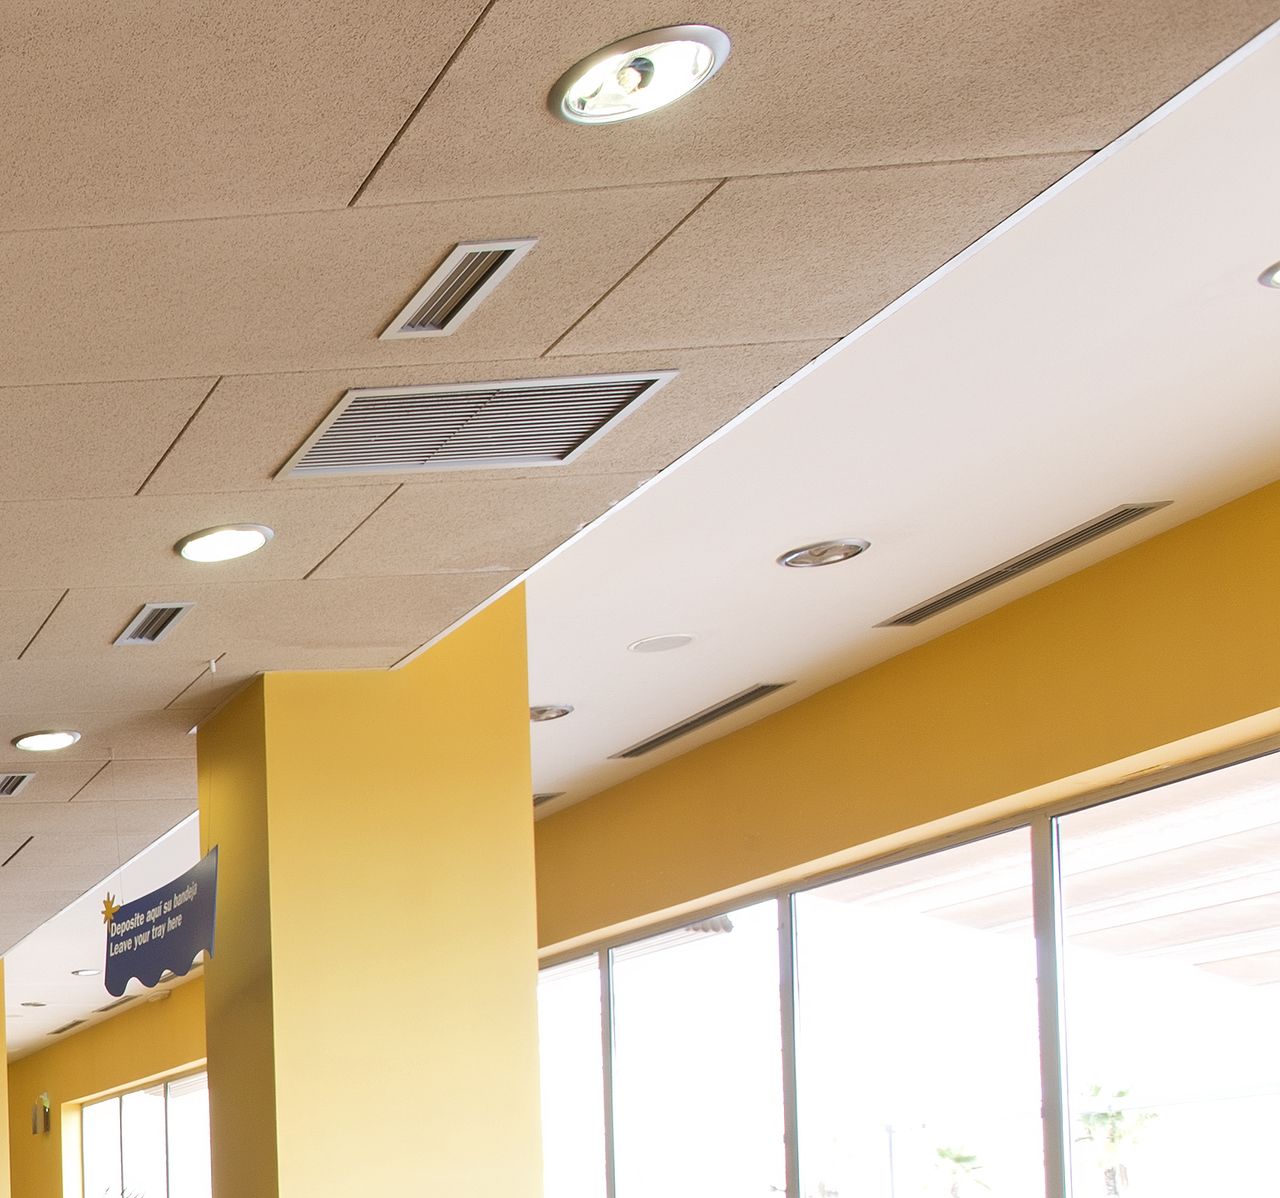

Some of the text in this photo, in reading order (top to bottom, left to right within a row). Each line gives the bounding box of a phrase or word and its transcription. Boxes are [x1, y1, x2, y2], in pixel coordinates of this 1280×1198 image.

[110, 881, 198, 938] Deposite aquí su bandeja
[109, 914, 183, 957] Leave your tray here
